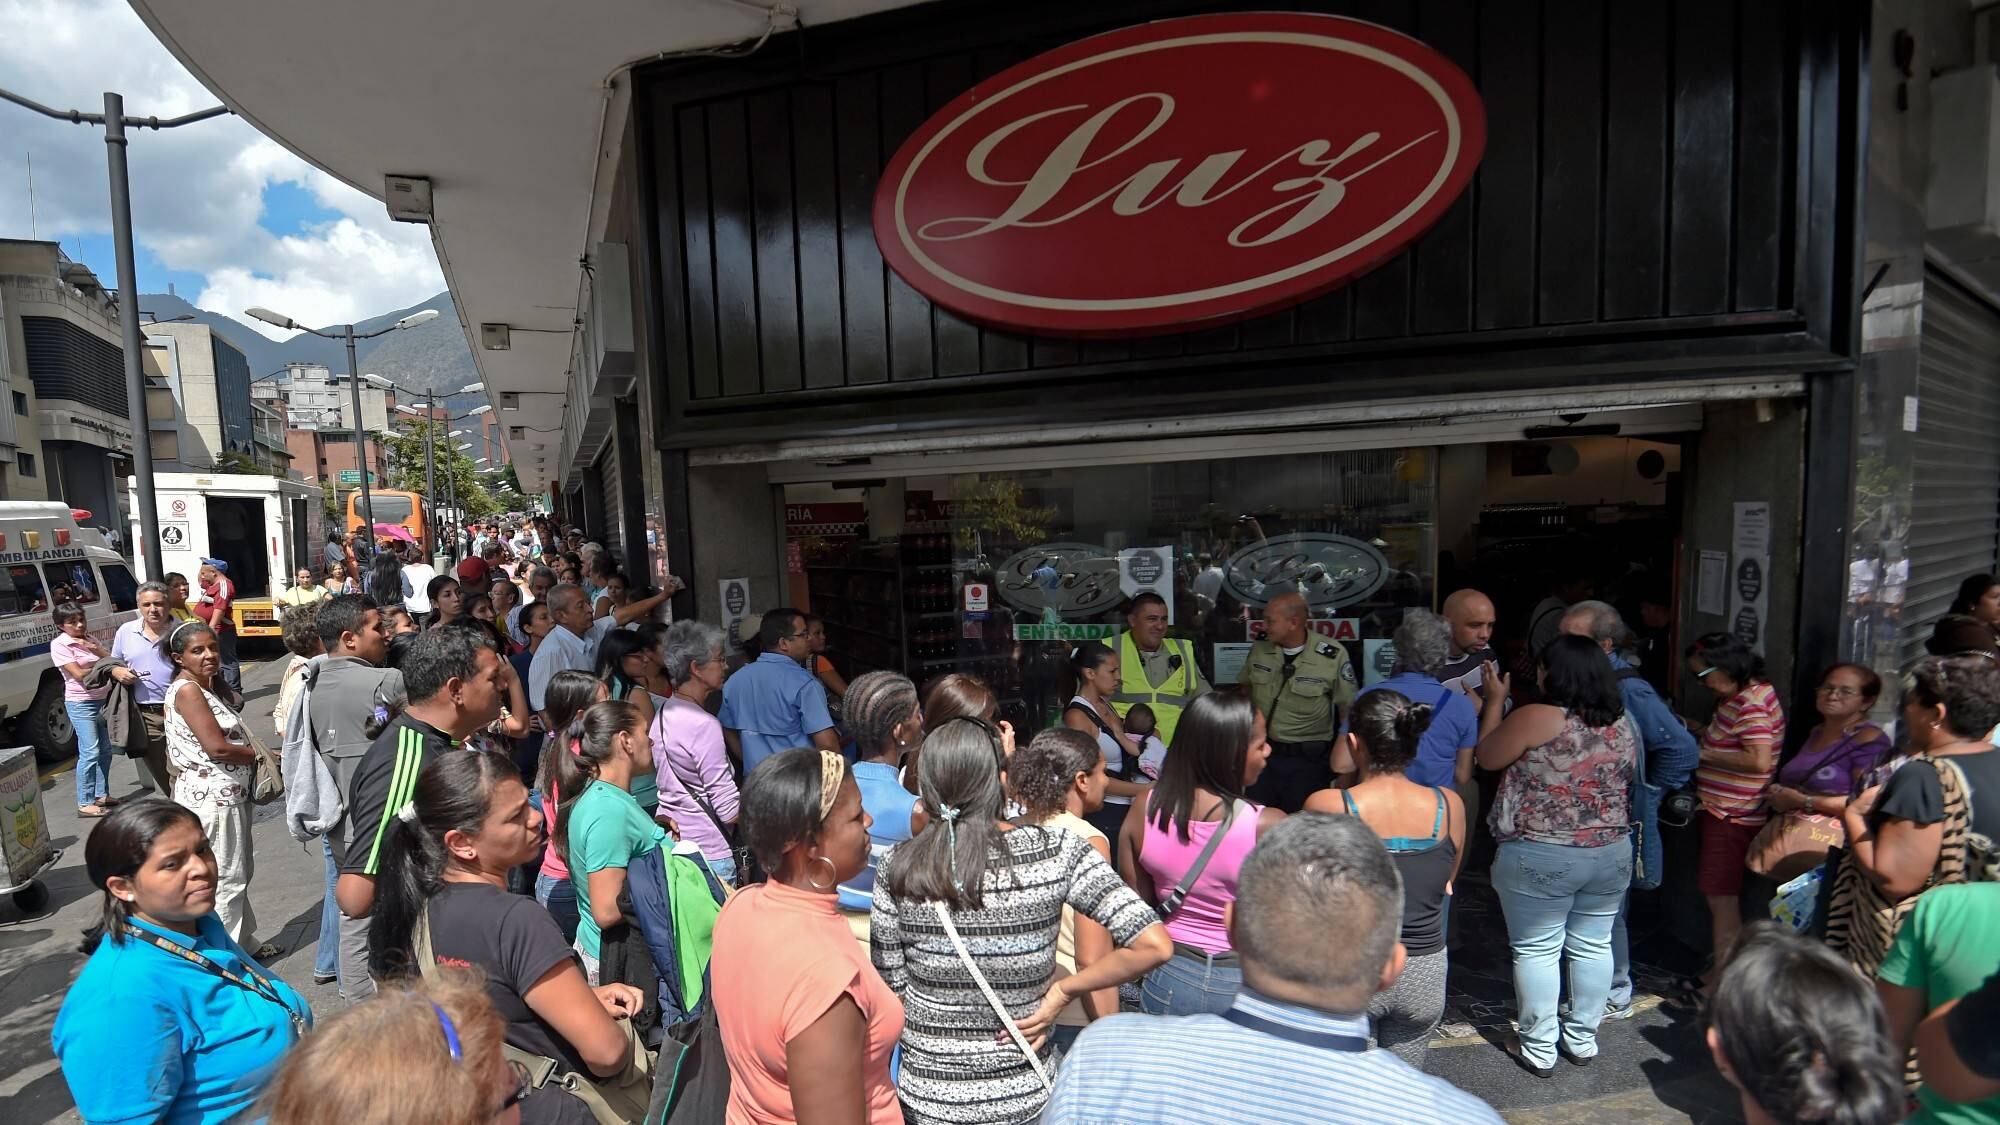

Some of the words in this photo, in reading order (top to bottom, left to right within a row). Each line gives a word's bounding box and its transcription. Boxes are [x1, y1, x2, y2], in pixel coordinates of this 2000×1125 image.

[917, 92, 1439, 248] Luz
[1018, 624, 1114, 640] ENTRADA
[1807, 826, 1839, 846] York
